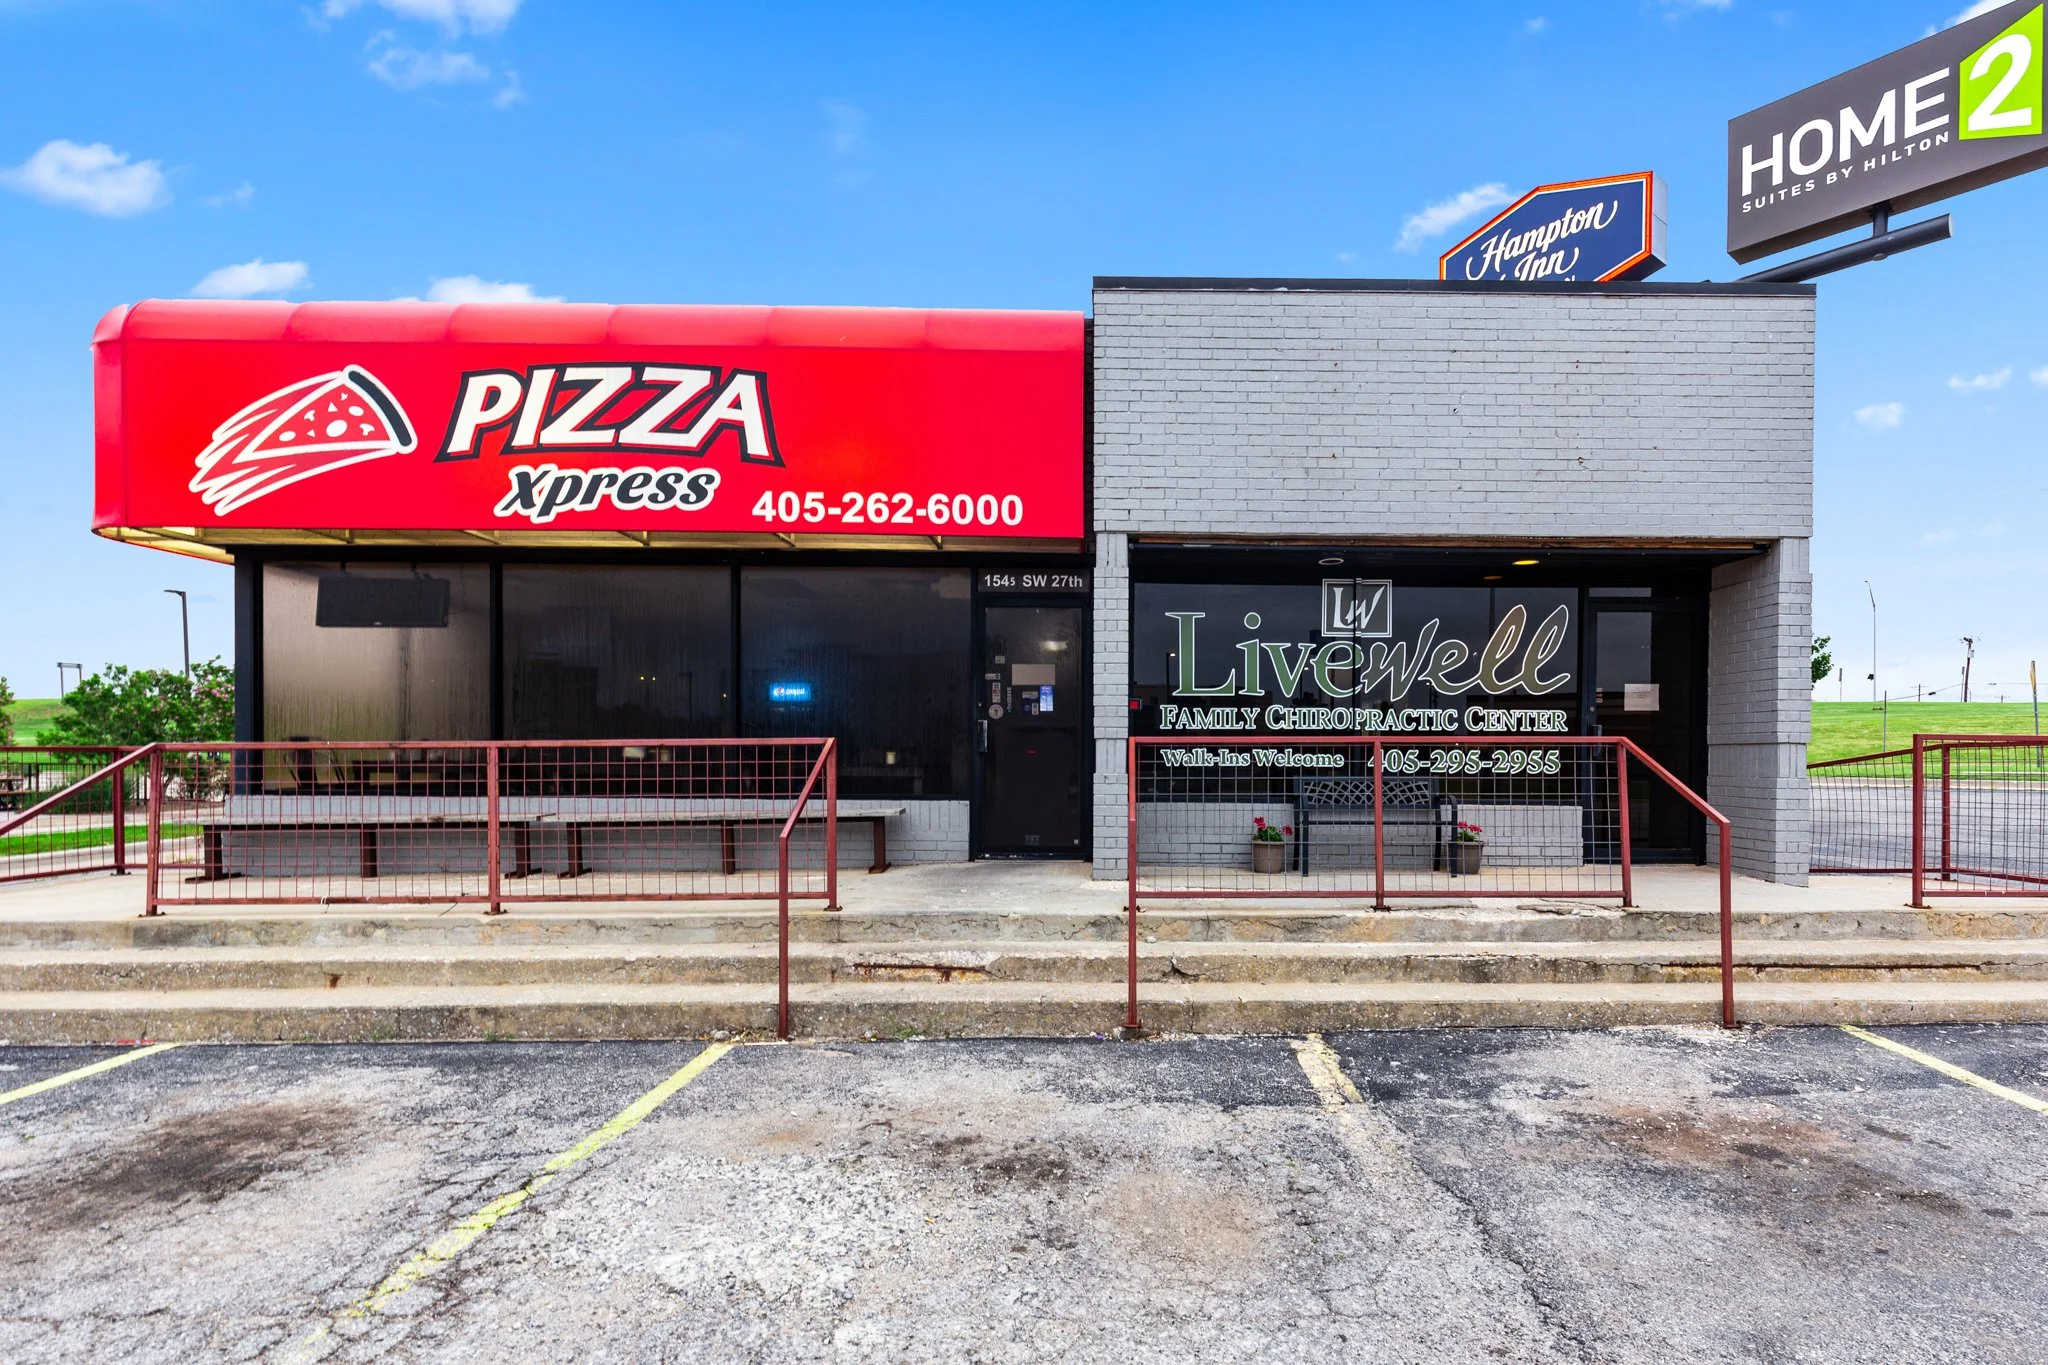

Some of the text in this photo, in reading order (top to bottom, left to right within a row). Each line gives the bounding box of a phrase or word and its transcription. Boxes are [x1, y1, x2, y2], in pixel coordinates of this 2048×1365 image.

[1741, 33, 2033, 197] HOME 2
[1742, 131, 1950, 213] SUITES BY HILTON
[1466, 200, 1618, 281] Hampton
[1514, 247, 1580, 281] Inn
[433, 361, 786, 468] PIZZA
[752, 490, 1023, 526] 405-262-6000
[984, 574, 1083, 588] 1545 SW 27th
[1165, 604, 1571, 702] Livewell
[1160, 704, 1568, 732] FAMILY CHIROPRACTIC CENTER
[1161, 748, 1345, 768] Walk-Ins Welcome
